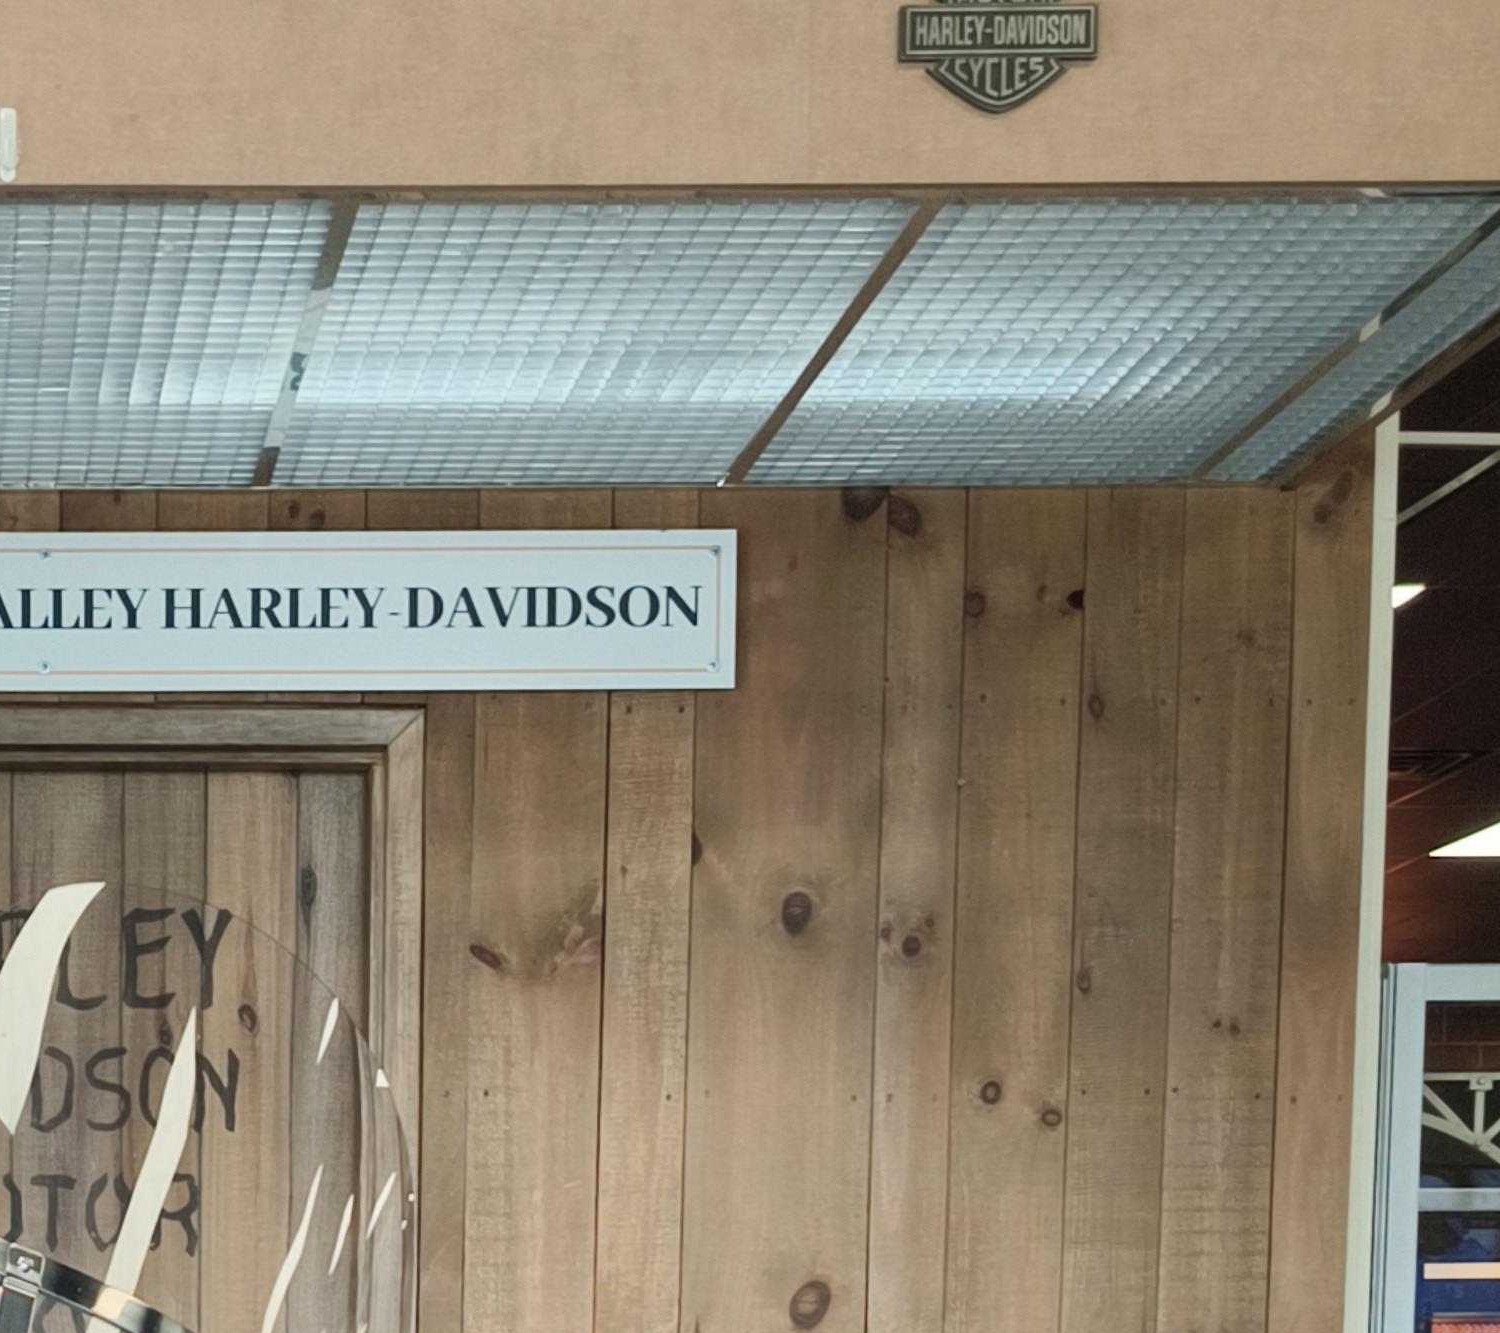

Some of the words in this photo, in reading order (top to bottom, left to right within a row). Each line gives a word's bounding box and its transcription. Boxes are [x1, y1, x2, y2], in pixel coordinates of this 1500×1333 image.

[915, 14, 1087, 46] HARLEY-DAVIDSON
[954, 57, 1044, 98] CYCLES
[161, 584, 704, 630] HARLEY-DAVIDSON
